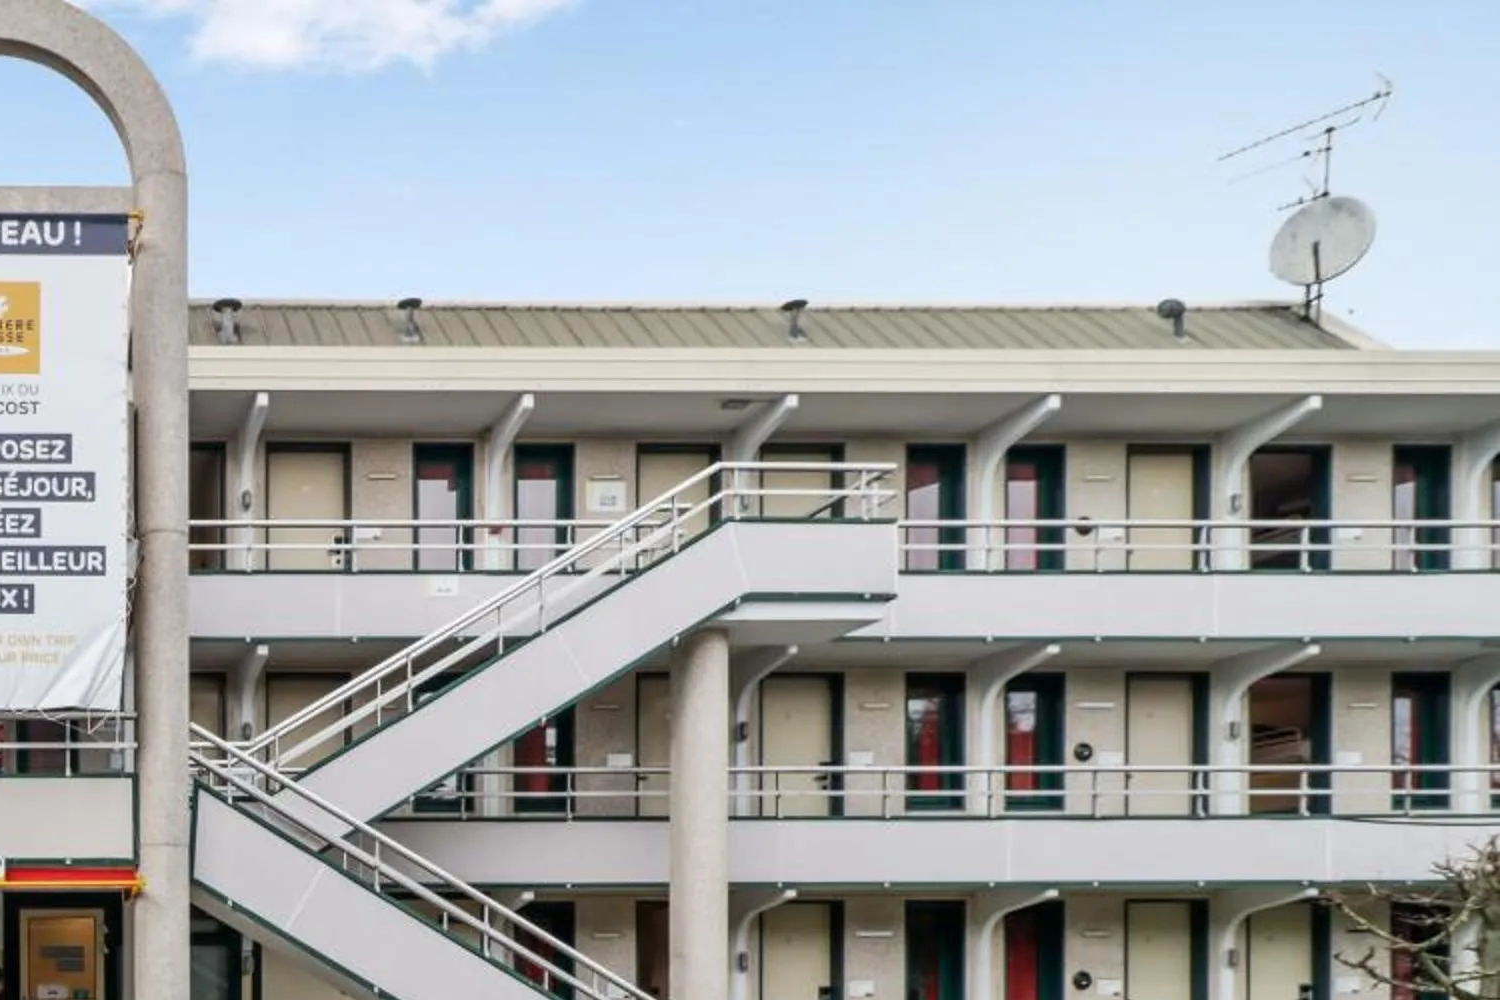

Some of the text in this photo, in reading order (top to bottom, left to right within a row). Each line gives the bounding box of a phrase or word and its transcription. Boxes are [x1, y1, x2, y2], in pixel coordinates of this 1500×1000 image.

[73, 220, 82, 247] !
[17, 383, 39, 396] DU
[23, 588, 29, 609] !
[7, 633, 41, 646] OWN
